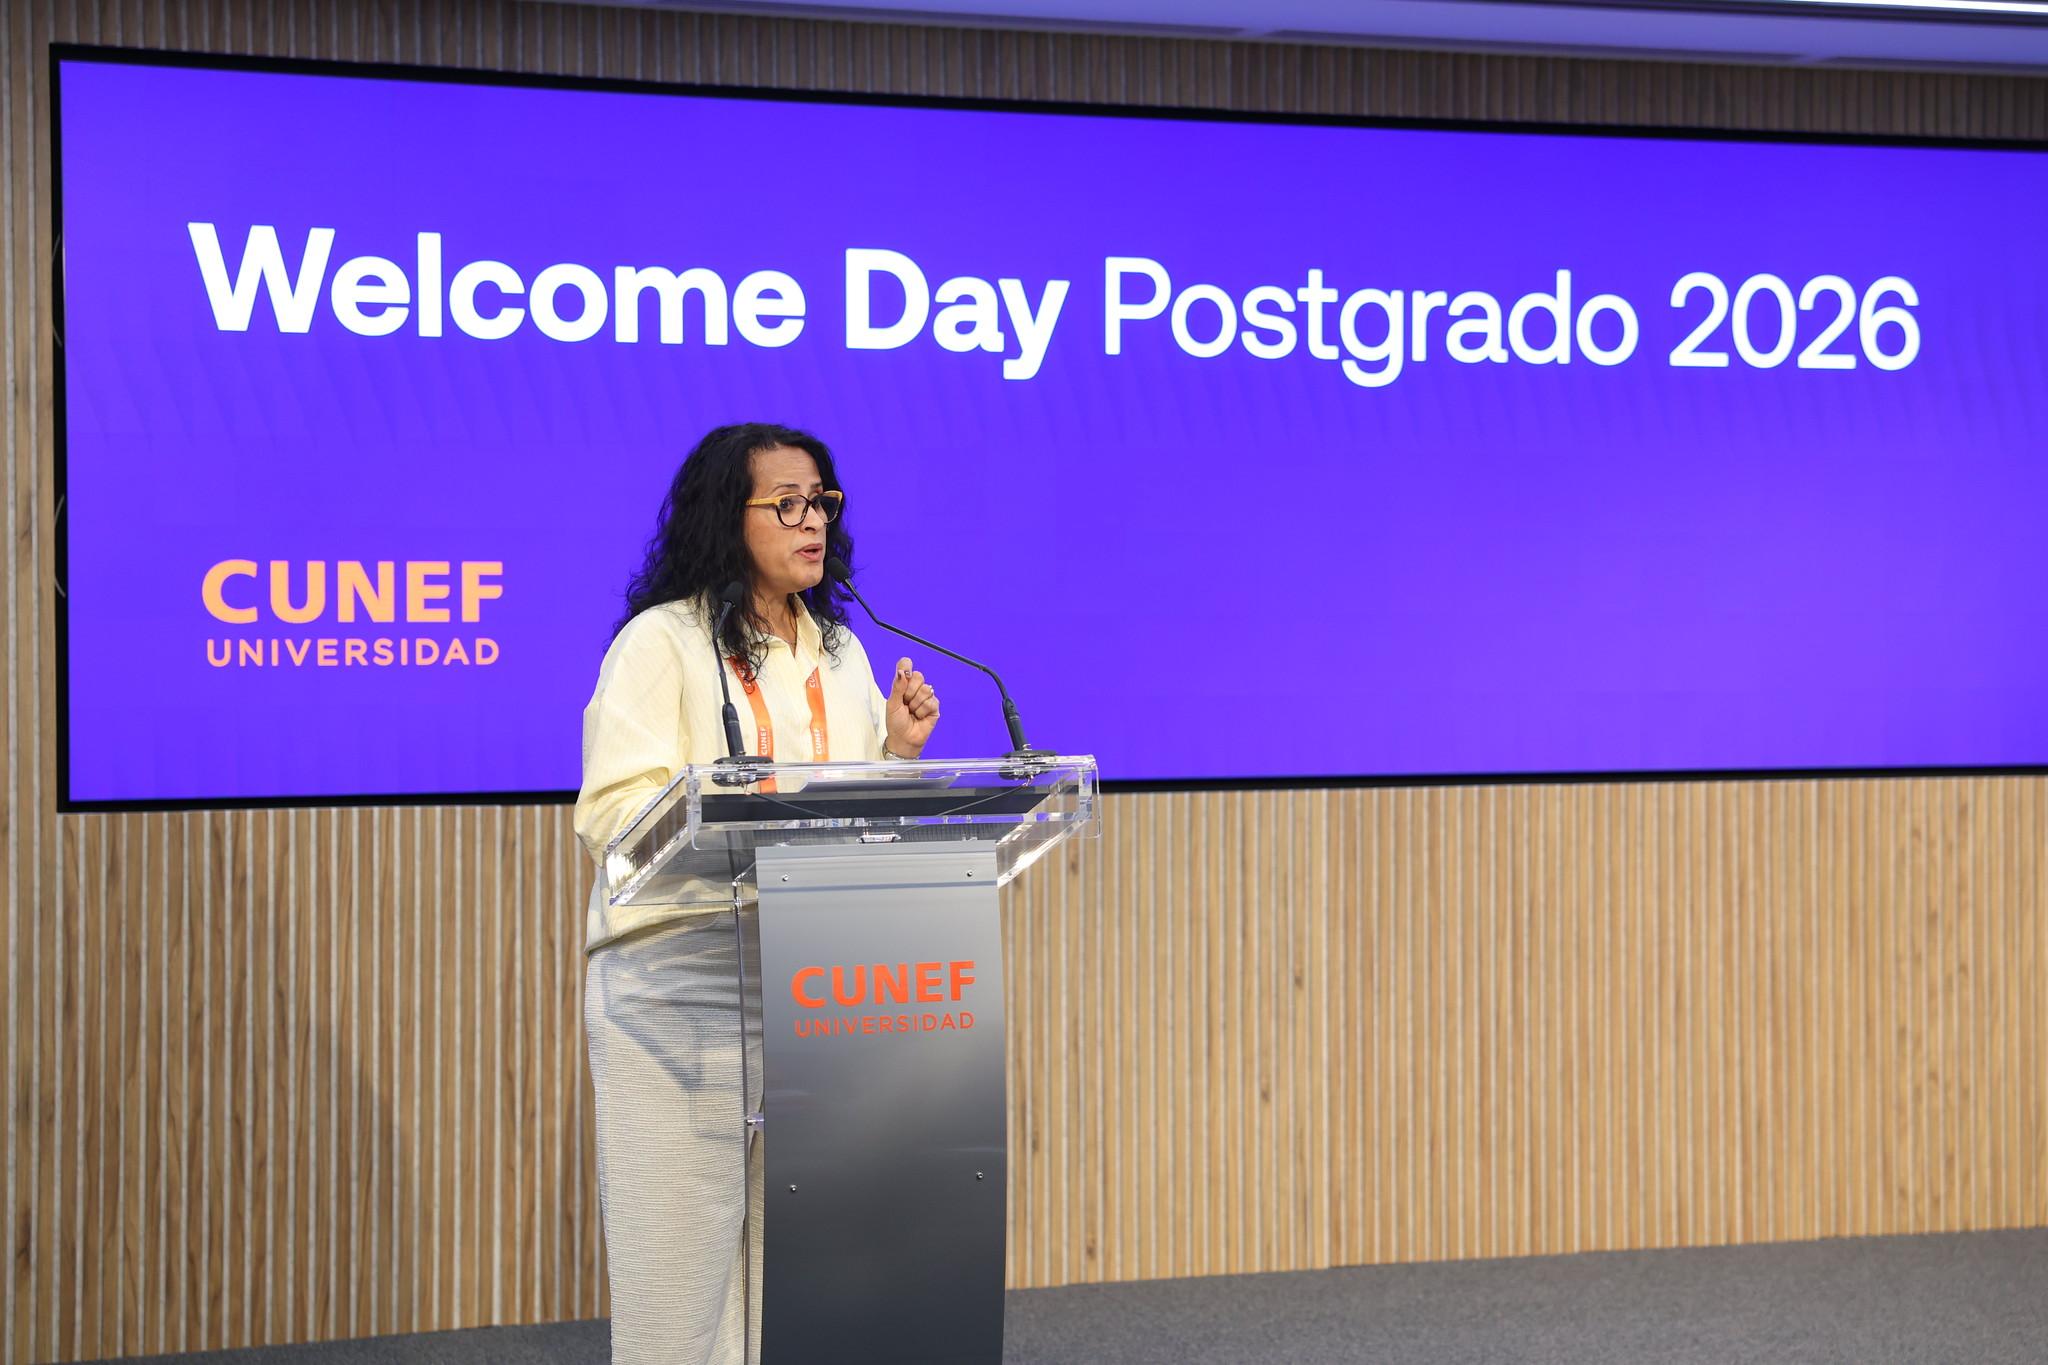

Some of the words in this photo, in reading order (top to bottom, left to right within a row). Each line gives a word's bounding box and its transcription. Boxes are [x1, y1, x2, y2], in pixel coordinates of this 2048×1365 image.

[188, 221, 806, 348] Welcome
[845, 247, 1070, 381] Day
[1104, 256, 1639, 388] Postgrado
[1669, 271, 1921, 371] 2026
[201, 559, 503, 624] CUNEF
[206, 638, 500, 668] UNIVERSIDAD
[760, 726, 768, 755] CUNEF
[791, 960, 977, 1009] CUNEF
[795, 1012, 975, 1038] UNIVERSIDAD
